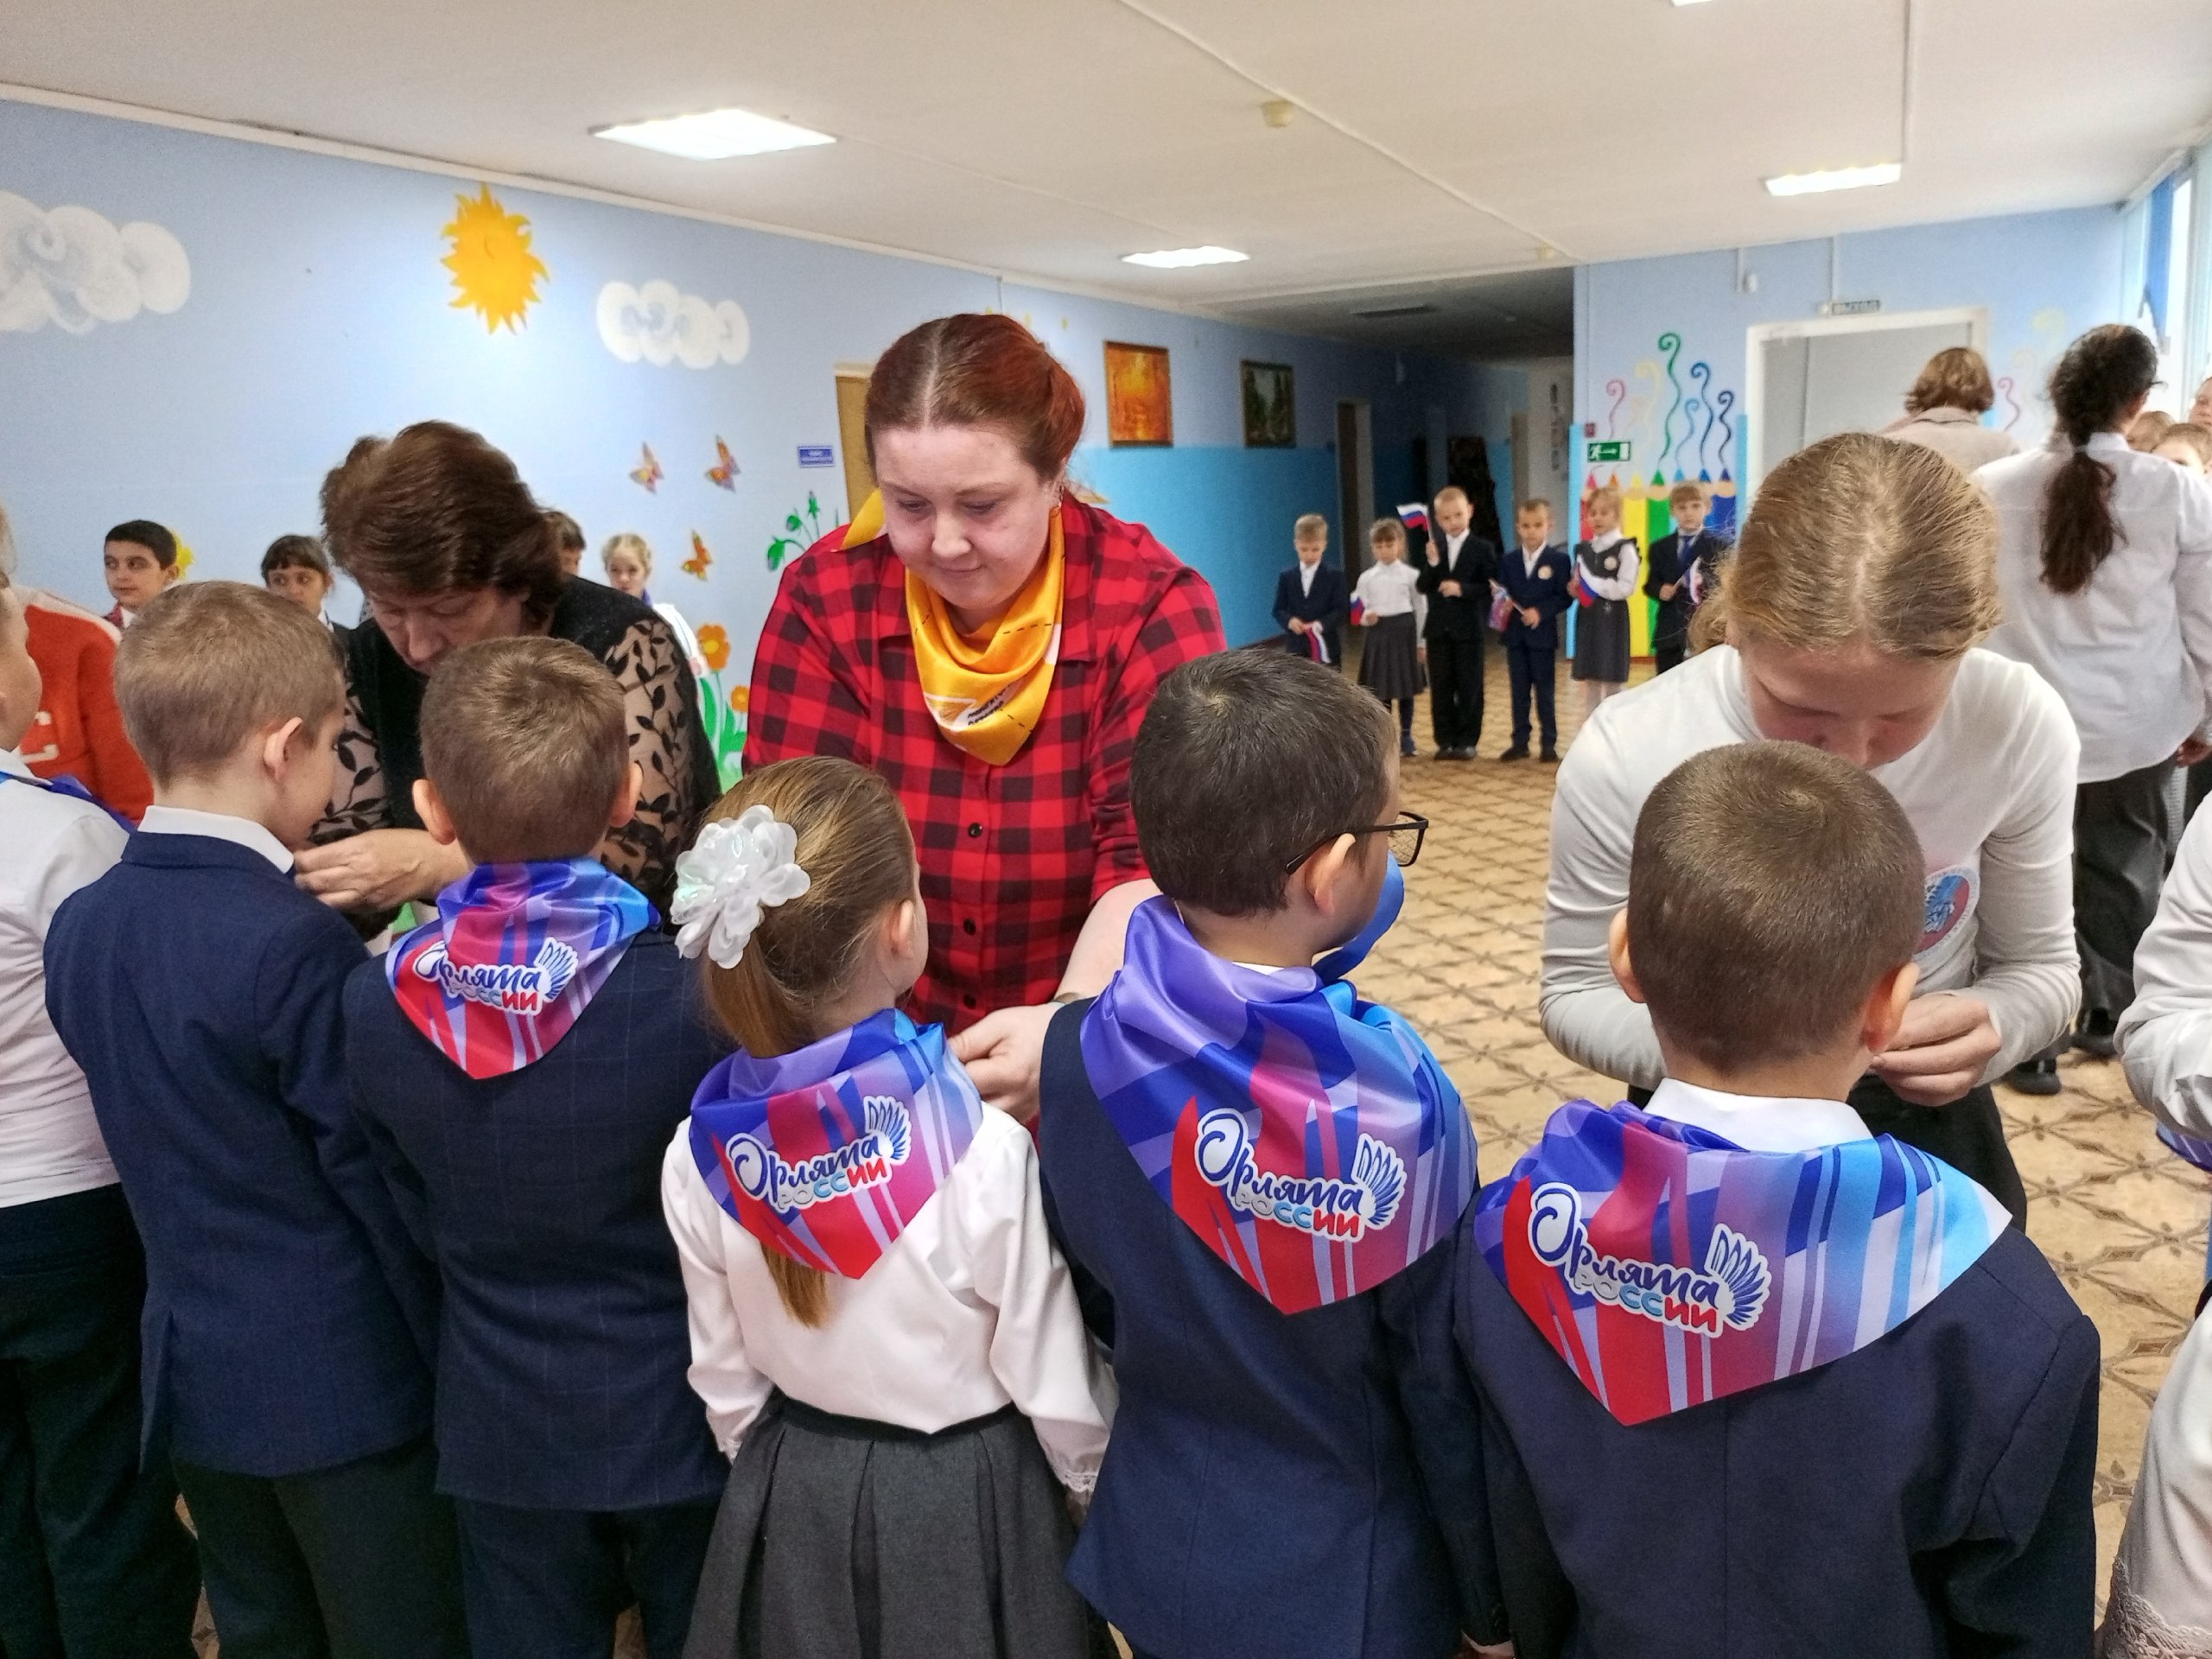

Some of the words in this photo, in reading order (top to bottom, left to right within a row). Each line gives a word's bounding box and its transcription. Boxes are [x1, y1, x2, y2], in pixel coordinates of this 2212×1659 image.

[728, 1133, 883, 1204] Орлята
[1198, 1112, 1364, 1216] Орлята
[1532, 1187, 1719, 1310] Орлята
